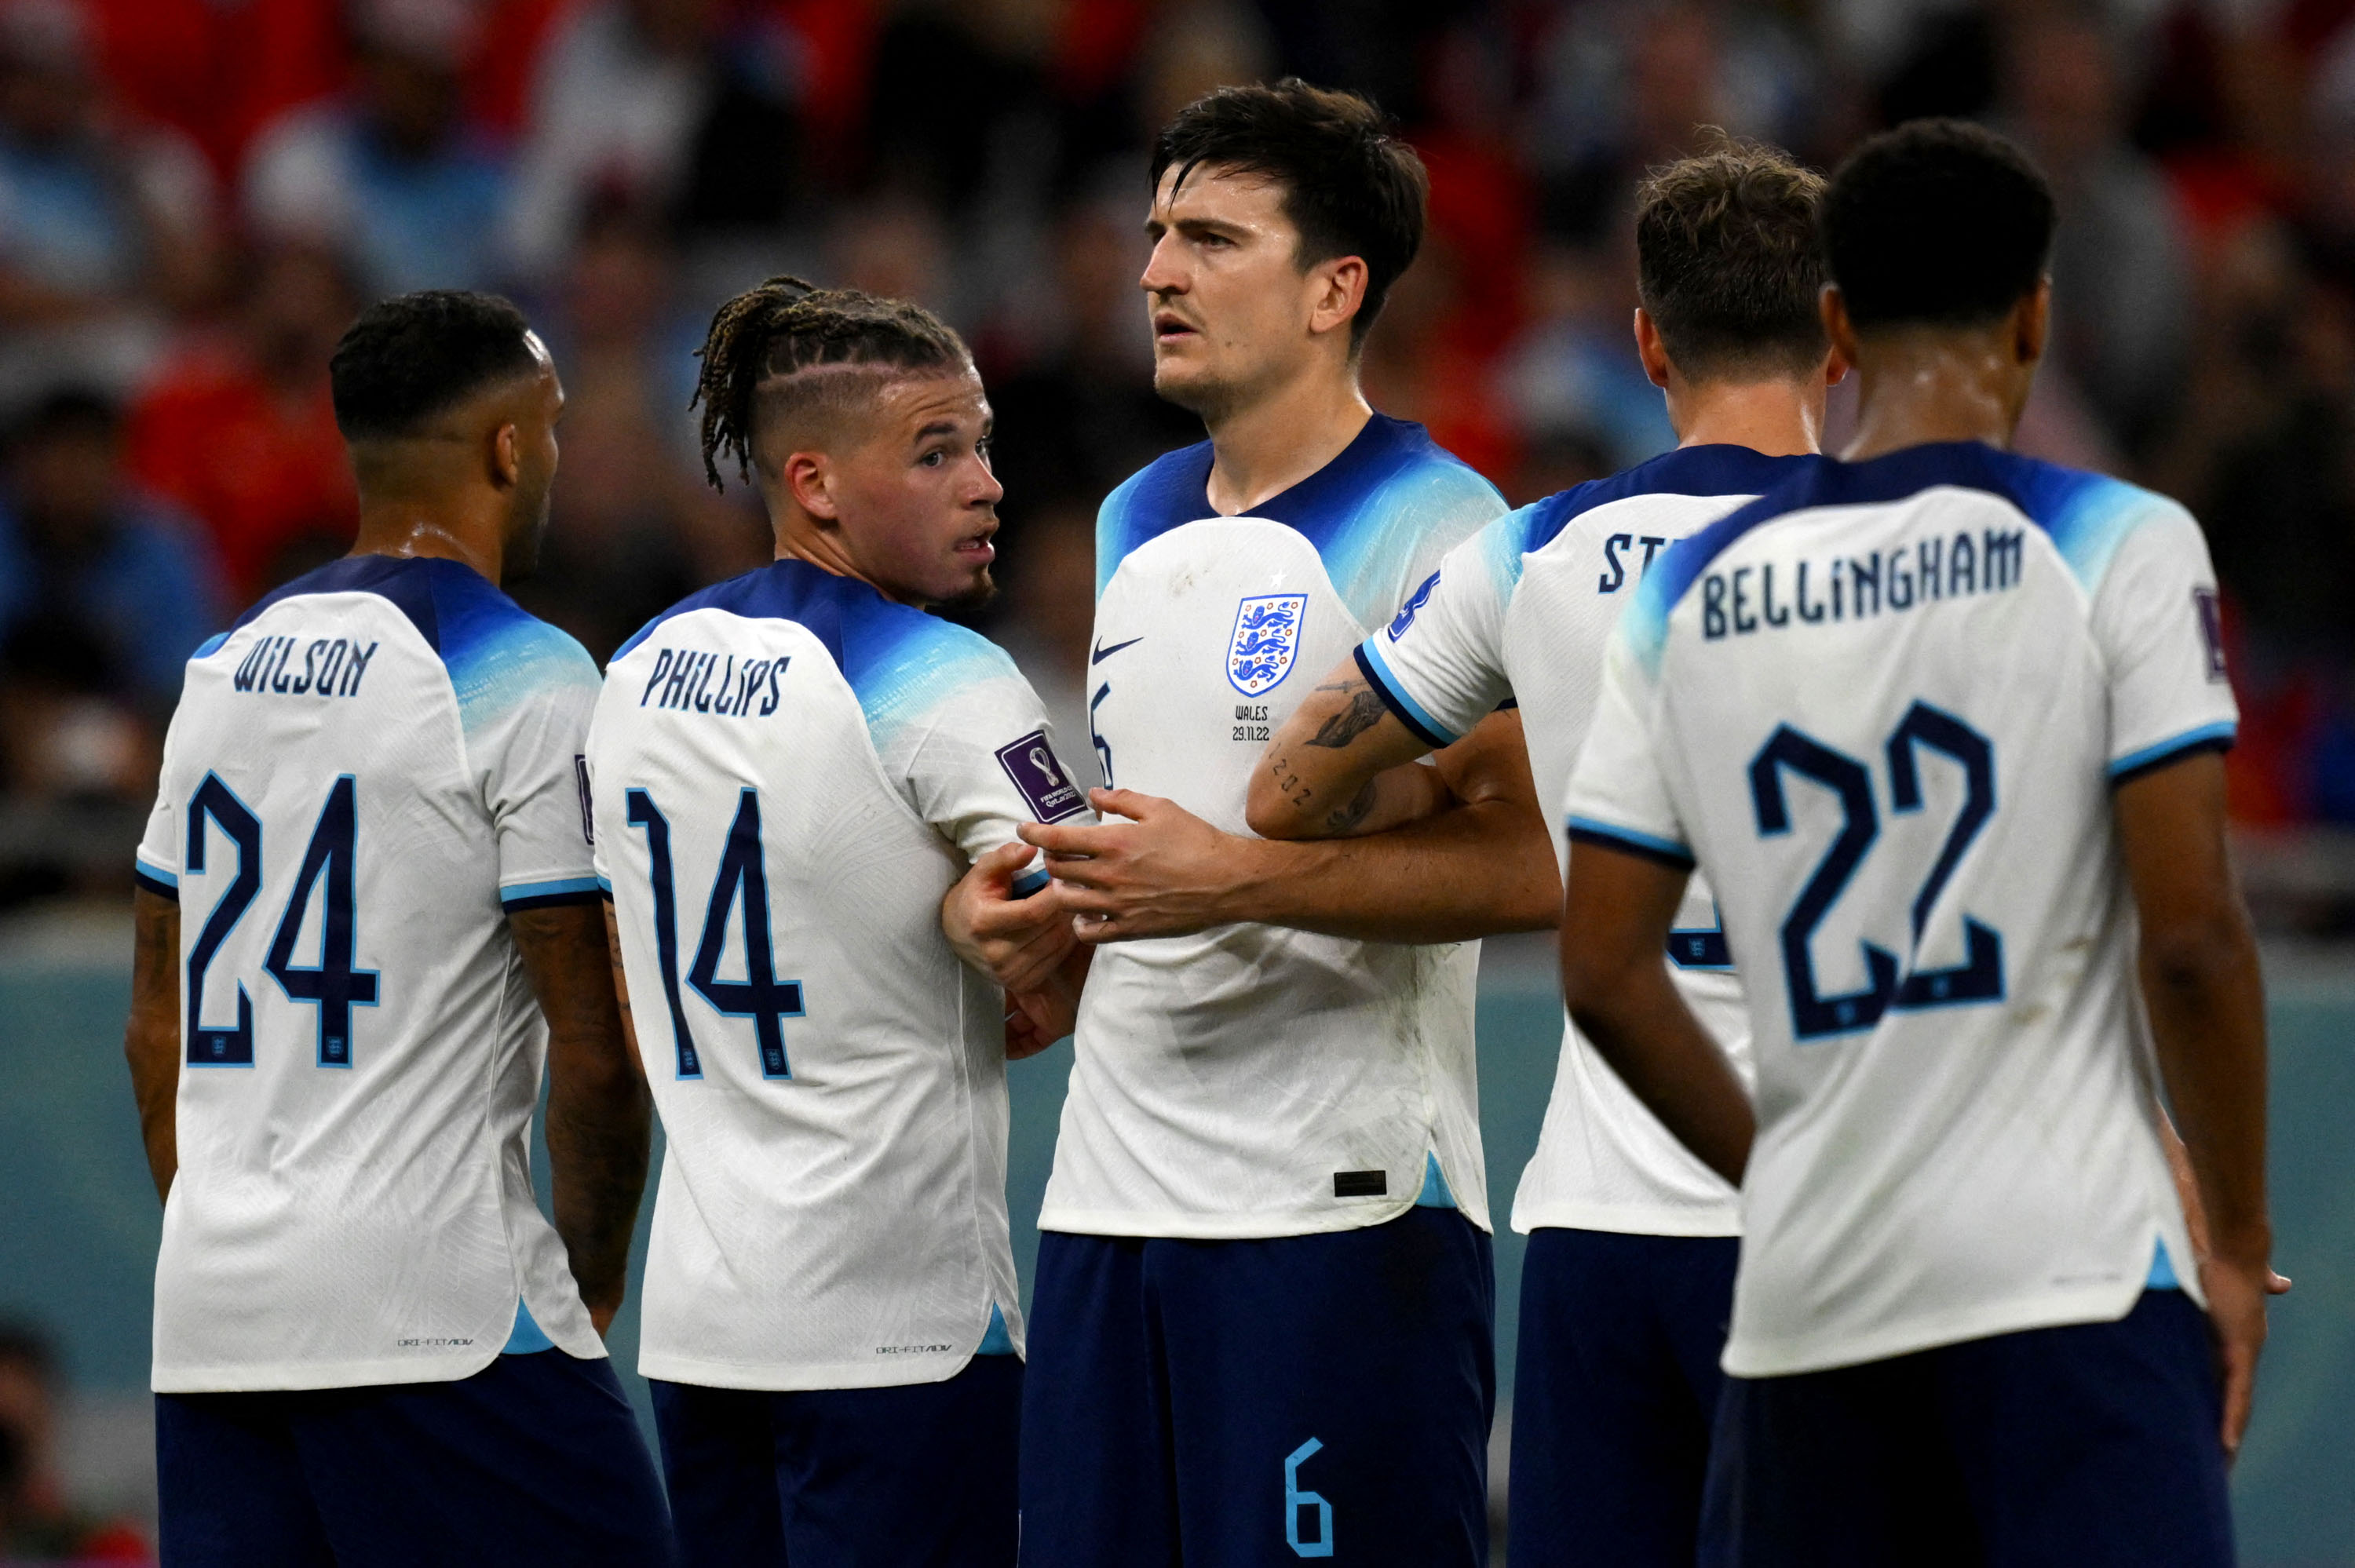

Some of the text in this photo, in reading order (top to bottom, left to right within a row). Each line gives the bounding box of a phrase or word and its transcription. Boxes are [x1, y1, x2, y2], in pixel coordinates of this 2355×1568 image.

[1702, 527, 2025, 641] BELLINGHAM
[234, 636, 380, 697] WILSON
[640, 648, 791, 717] PHILLIPS
[1232, 727, 1269, 741] 29.11.22
[1235, 706, 1268, 720] WALES
[1040, 793, 1053, 803] FIFA
[1052, 787, 1068, 797] WORLD
[1747, 698, 2006, 1044] 22
[185, 768, 380, 1068] 24
[625, 786, 806, 1081] 14
[1285, 1436, 1333, 1558] 6
